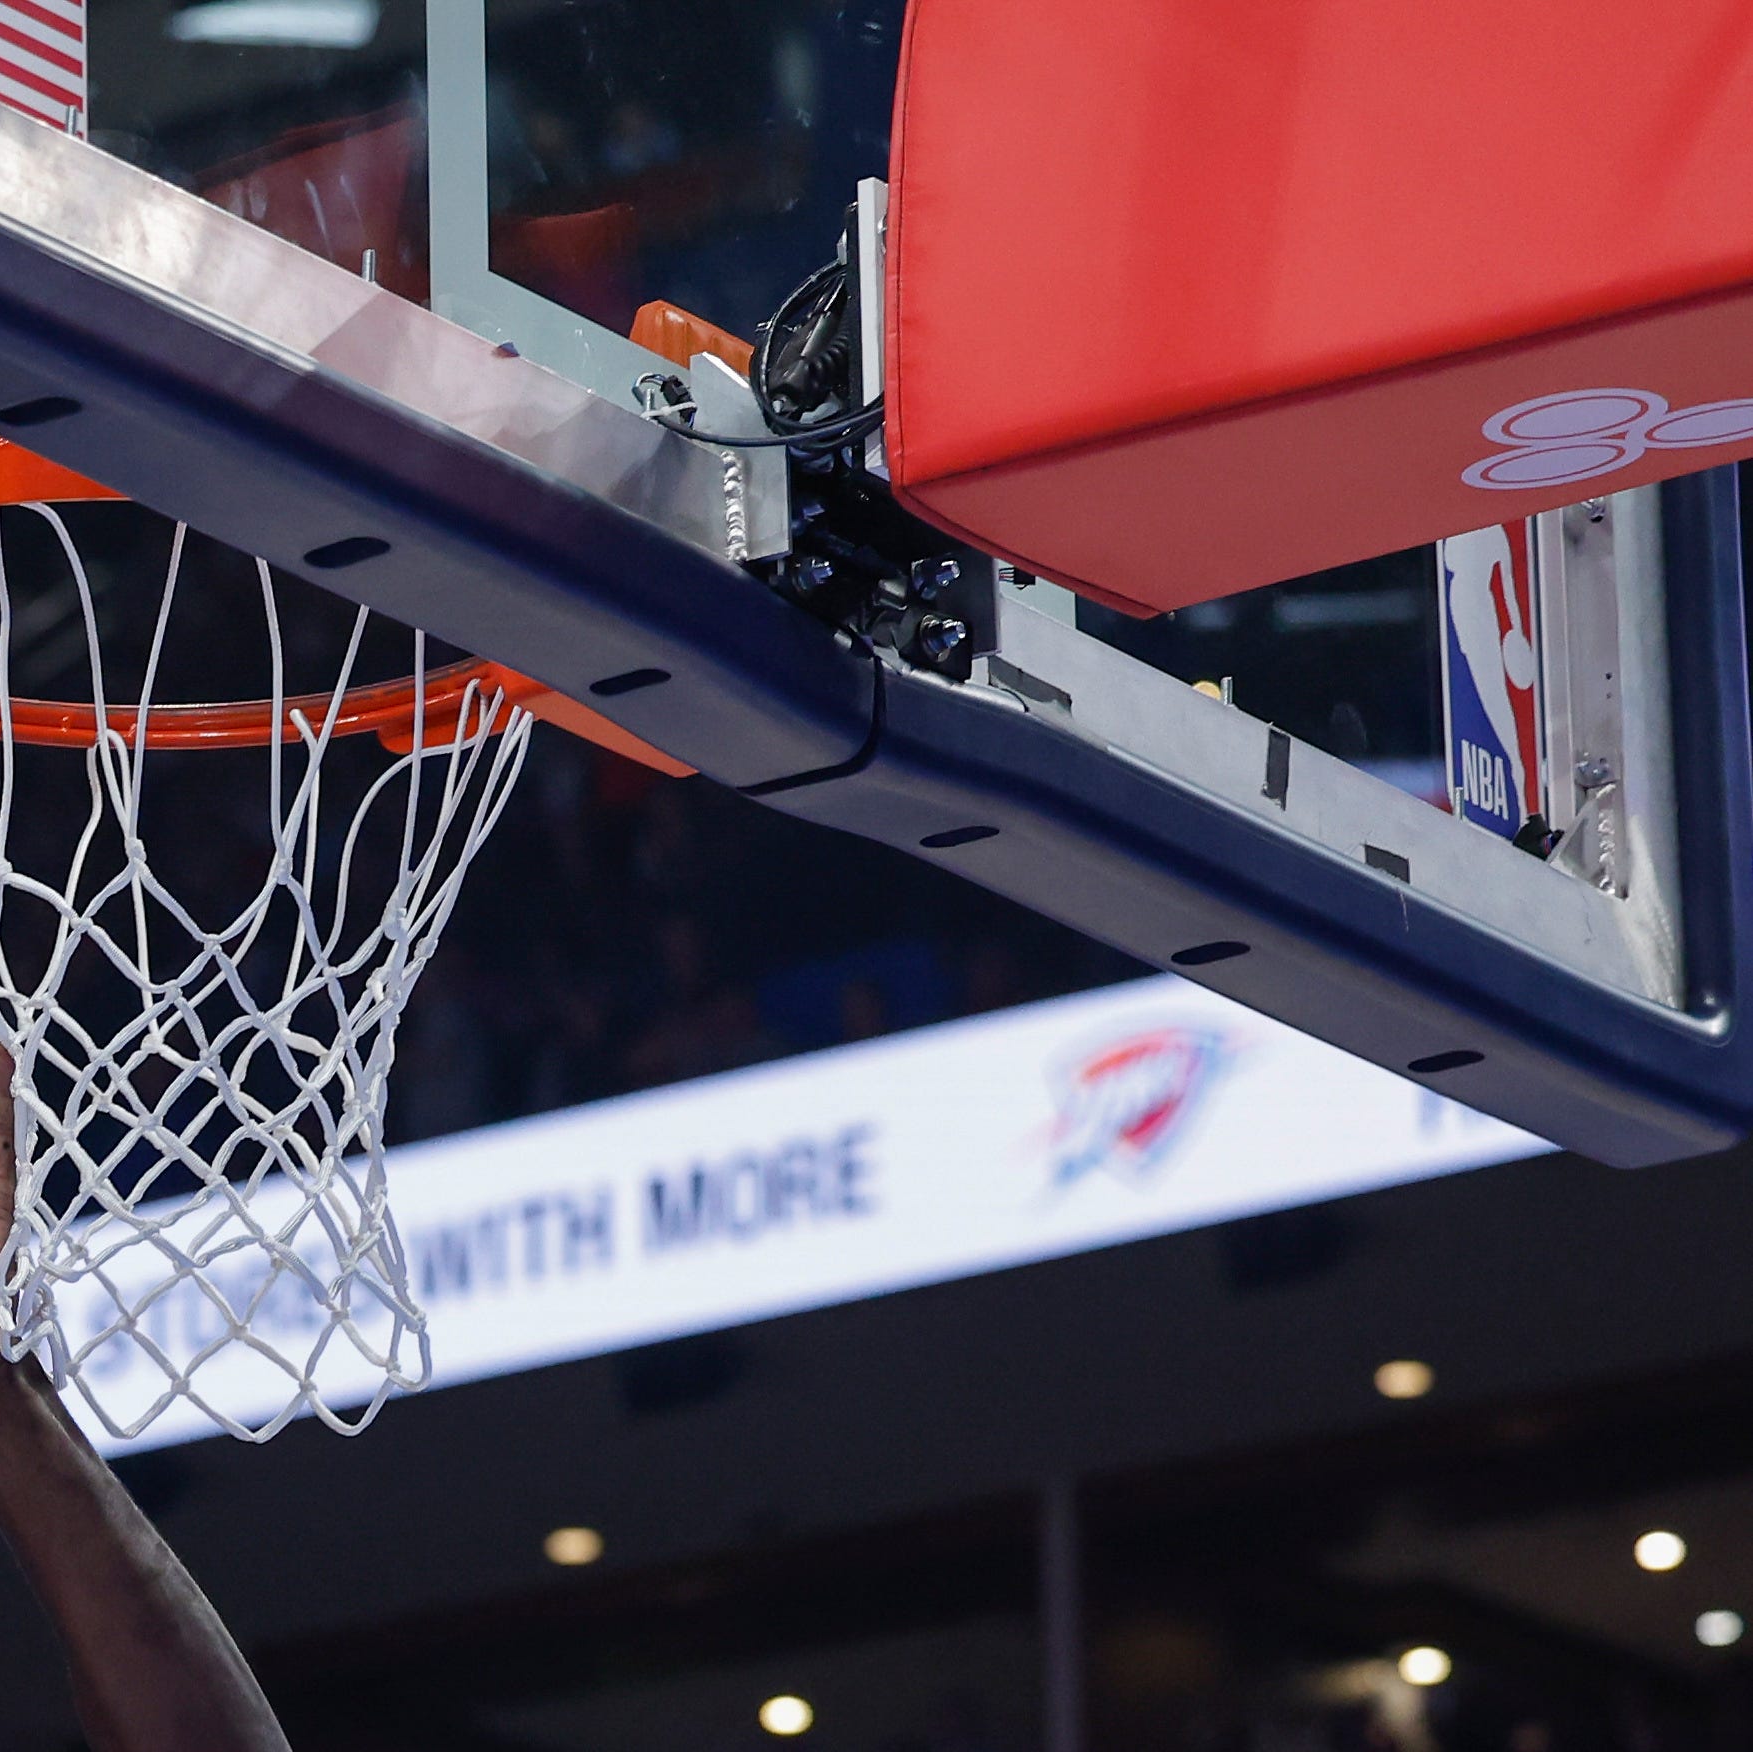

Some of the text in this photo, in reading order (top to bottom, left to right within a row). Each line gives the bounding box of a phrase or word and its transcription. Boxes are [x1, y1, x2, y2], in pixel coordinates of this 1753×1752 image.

[1461, 739, 1509, 821] NBA
[408, 1181, 614, 1297] WITH
[644, 1119, 877, 1255] MORE
